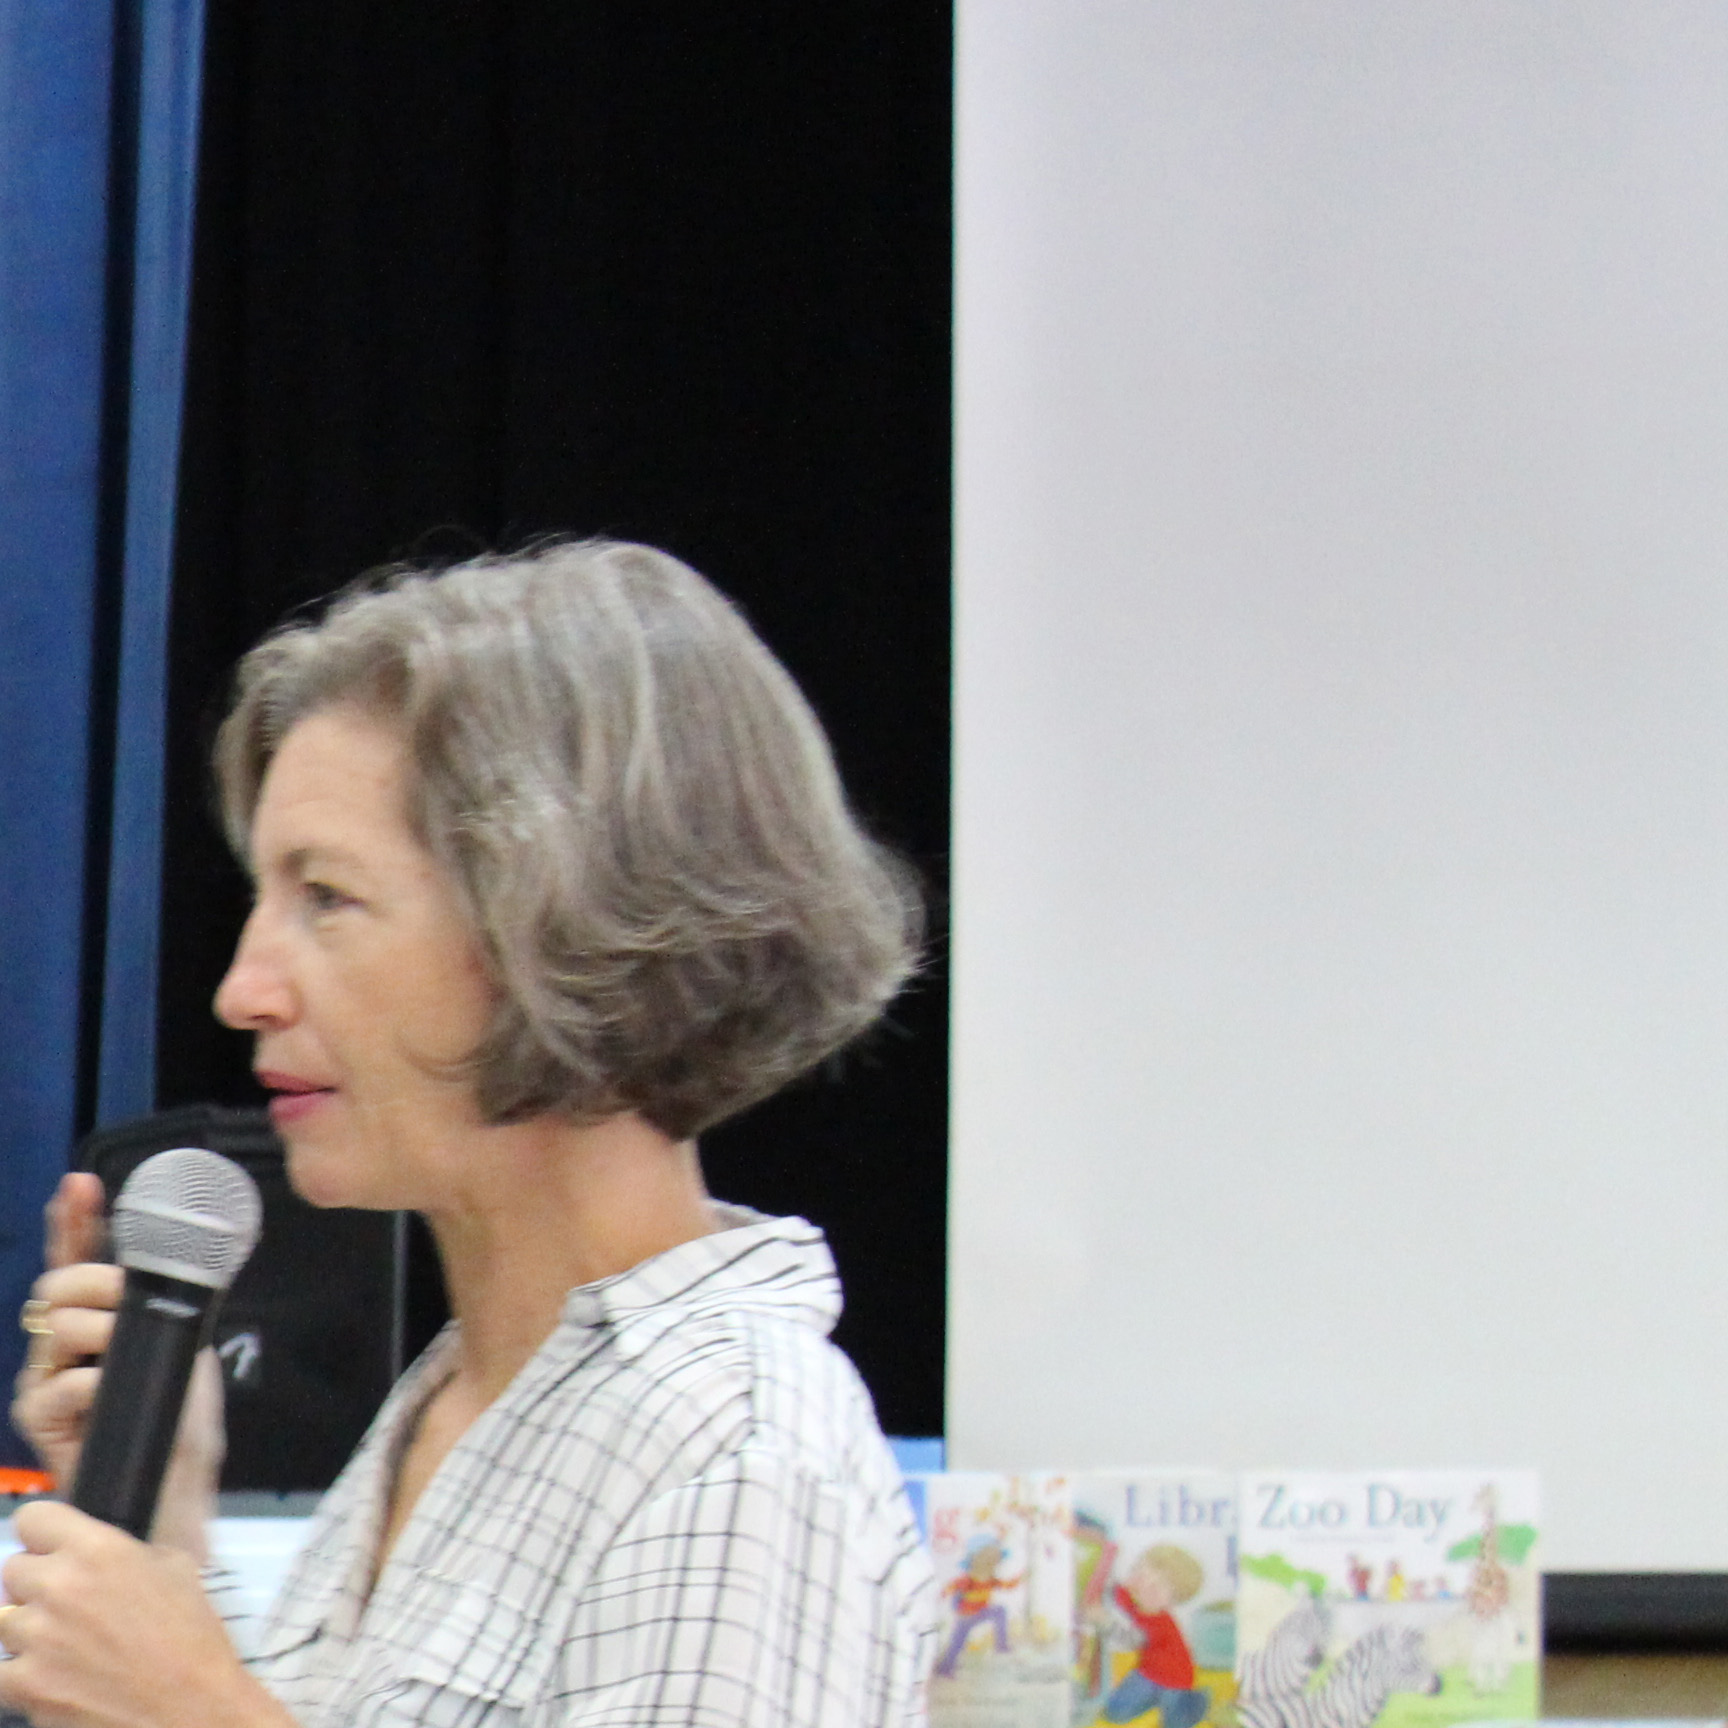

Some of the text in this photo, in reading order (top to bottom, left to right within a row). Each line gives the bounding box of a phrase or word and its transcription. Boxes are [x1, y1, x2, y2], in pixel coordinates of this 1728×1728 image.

[1125, 1483, 1237, 1529] Libr
[1257, 1483, 1453, 1546] Zoo Day
